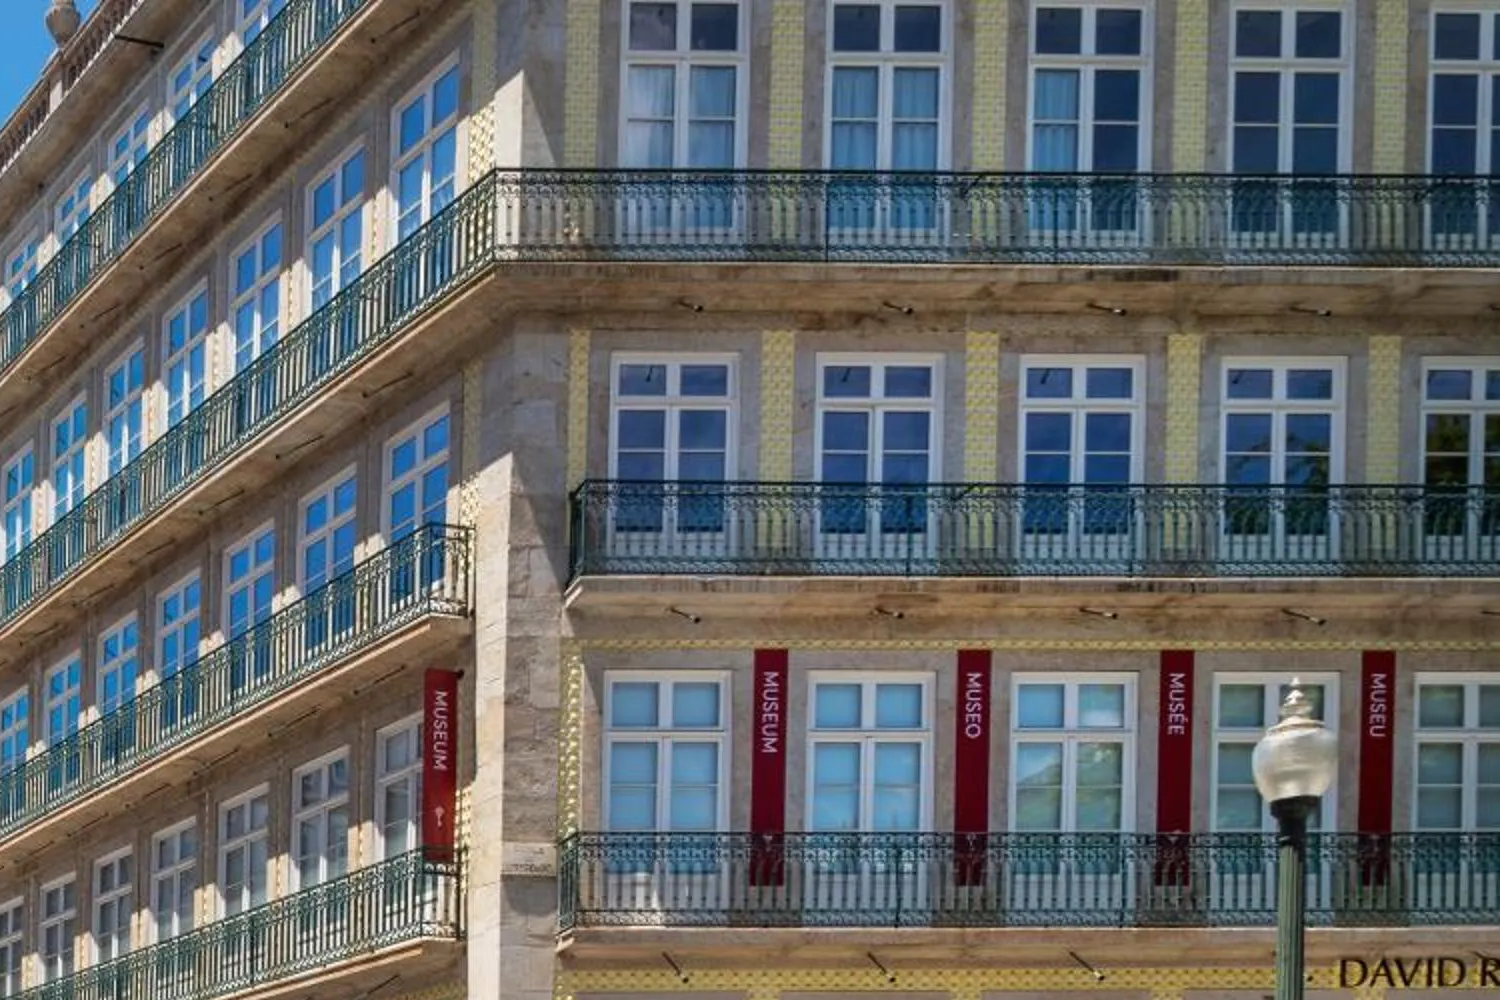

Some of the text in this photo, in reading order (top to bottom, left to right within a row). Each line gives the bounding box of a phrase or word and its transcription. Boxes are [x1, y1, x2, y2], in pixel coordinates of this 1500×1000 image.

[432, 690, 449, 771] MUSEUM
[761, 671, 780, 753] MUSEUM
[965, 672, 983, 739] MUSEO
[1167, 673, 1188, 735] MUSÉE
[1369, 673, 1387, 738] MUSEU
[1339, 957, 1466, 988] DAVID
